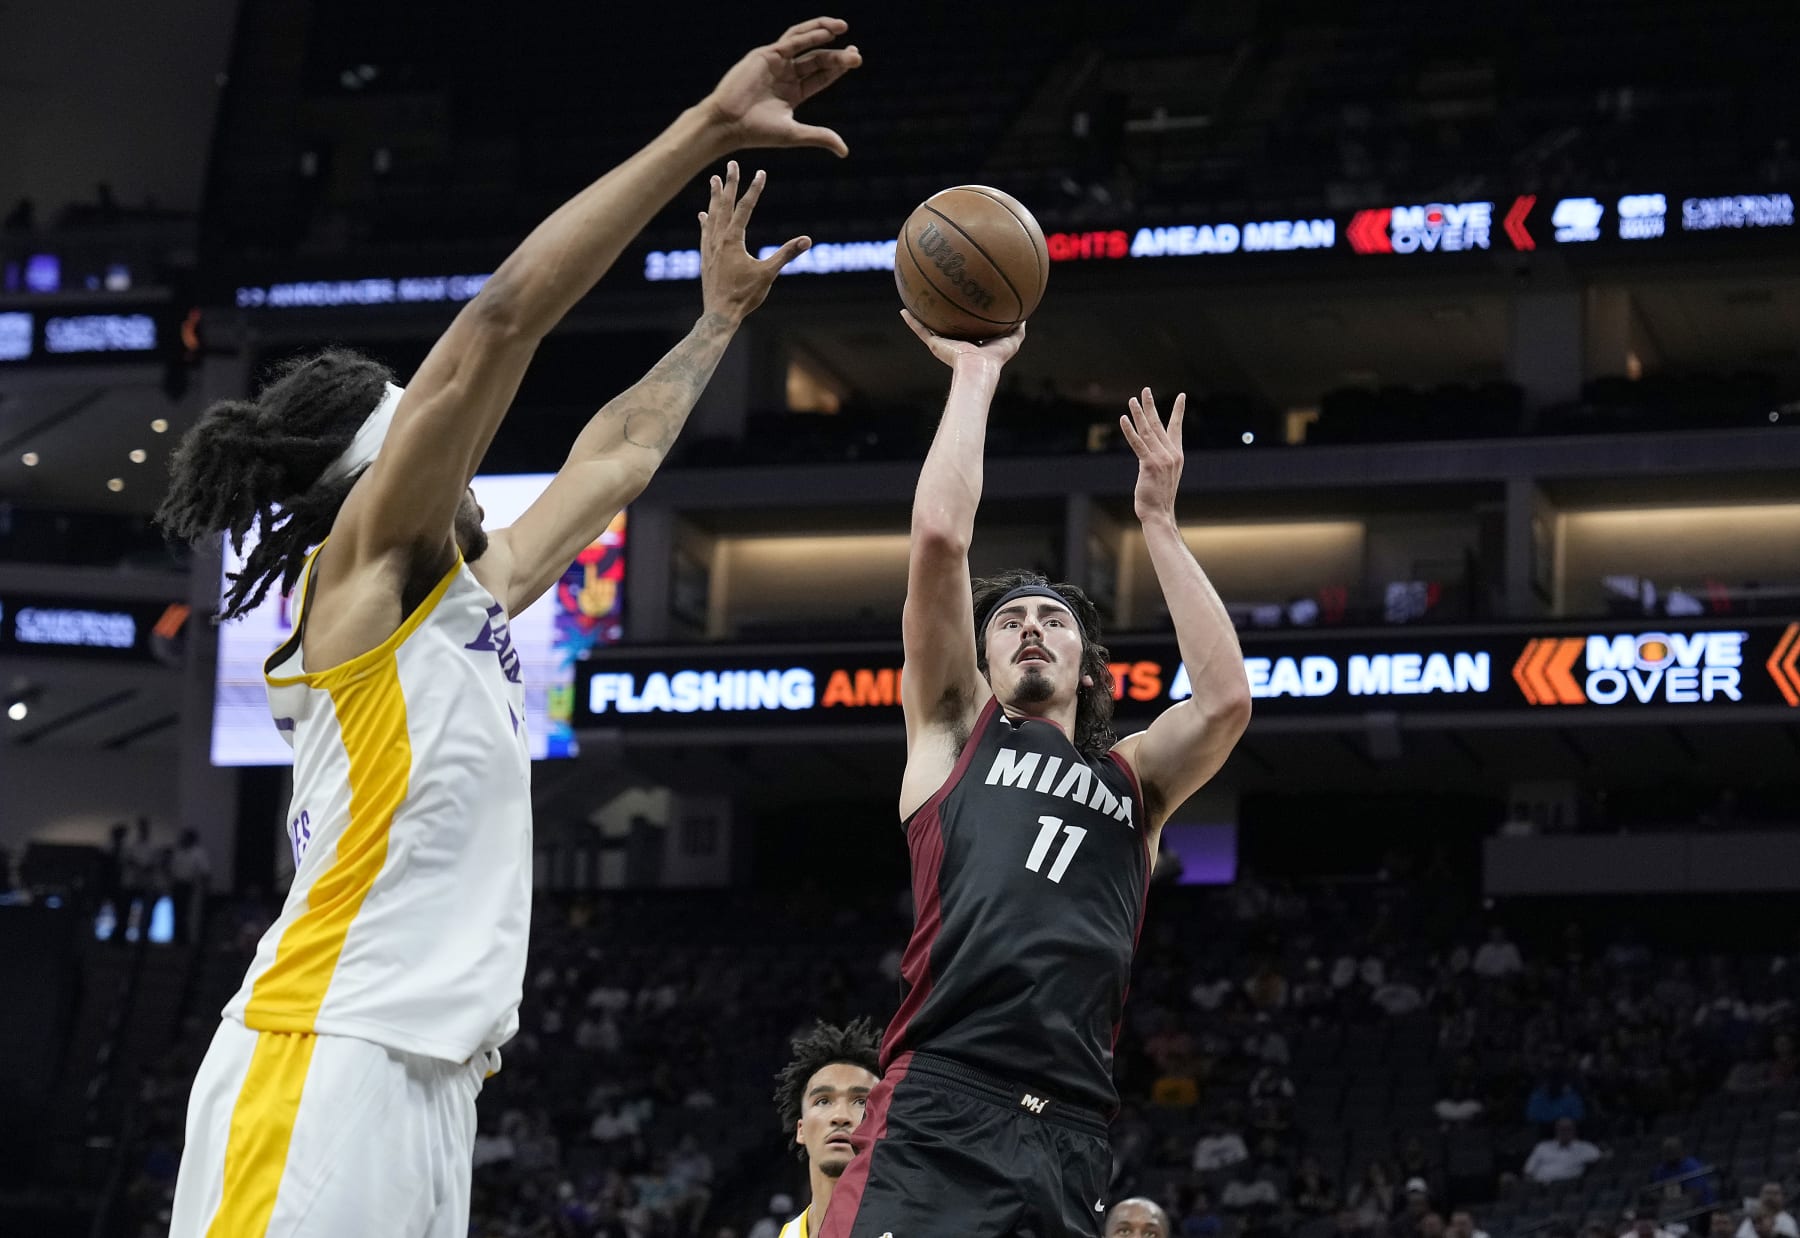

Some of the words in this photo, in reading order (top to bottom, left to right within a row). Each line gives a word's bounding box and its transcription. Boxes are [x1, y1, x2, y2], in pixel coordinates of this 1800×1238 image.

[1130, 224, 1240, 258] AHEAD
[1242, 218, 1335, 252] MEAN
[1586, 632, 1743, 671] MOVE
[589, 668, 814, 713] FLASHING
[1168, 656, 1339, 701] AEAD
[1347, 652, 1491, 695] MEAN
[1585, 667, 1742, 705] OVER
[1025, 815, 1088, 884] 11
